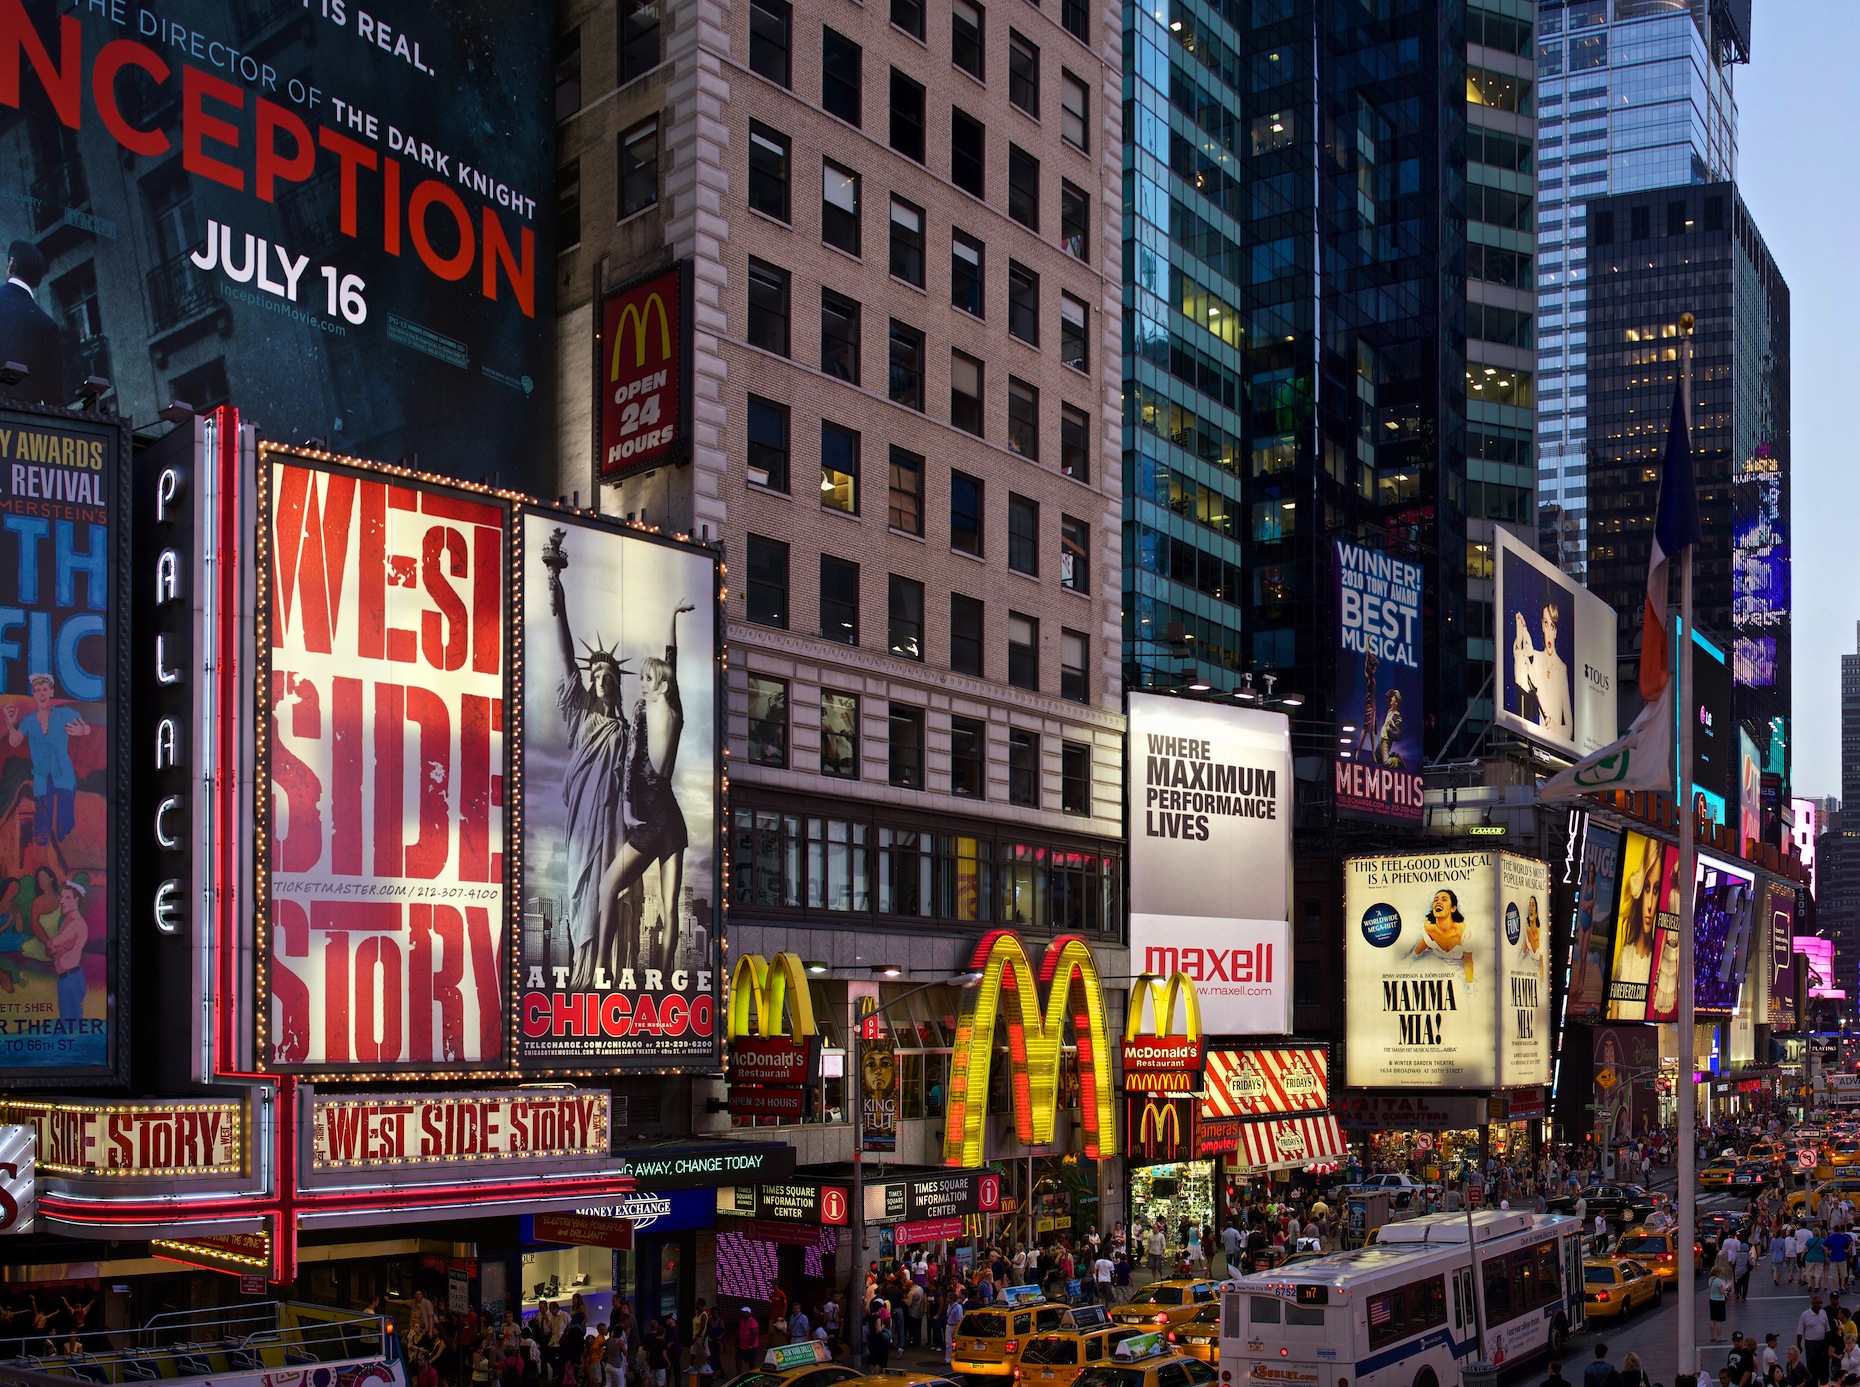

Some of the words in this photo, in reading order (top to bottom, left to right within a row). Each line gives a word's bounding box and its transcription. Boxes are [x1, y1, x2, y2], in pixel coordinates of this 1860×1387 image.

[358, 12, 436, 76] REAL.
[140, 9, 276, 92] DIRECTOR
[288, 79, 321, 109] OF
[332, 98, 378, 141] THE
[389, 125, 450, 177] DARK
[458, 159, 536, 221] KNIGHT
[190, 219, 310, 302] JULY
[321, 265, 367, 325] 16
[221, 281, 346, 338] InceptionMovie.com
[614, 369, 668, 405] OPEN
[620, 395, 661, 442] 24
[16, 432, 103, 471] AWARDS
[607, 425, 674, 465] HOURS
[12, 463, 105, 507] REVIVAL
[1337, 541, 1421, 591] WINNER!
[1341, 568, 1363, 588] 2010
[1367, 575, 1387, 599] TONY
[1391, 584, 1418, 607] AWARD
[1341, 588, 1418, 644] BEST
[1341, 629, 1418, 668] MUSICAL
[1589, 665, 1609, 691] TOUS
[1147, 733, 1211, 761] WHERE
[1147, 756, 1276, 798] MAXIMUM
[1335, 761, 1424, 807] MEMPHIS
[1147, 787, 1276, 820] PERFORMANCE
[1147, 810, 1210, 841] LIVES
[1471, 827, 1504, 835] LAMAR
[1381, 858, 1440, 872] FEEL-GOOD
[1444, 855, 1492, 869] MUSICAL
[1585, 847, 1616, 878] HUGE
[417, 886, 499, 900] 212-307-4100
[1368, 874, 1378, 885] IS
[1364, 914, 1398, 926] WORLDWIDE
[1145, 943, 1273, 983] maxell
[527, 966, 569, 988] AT
[595, 968, 712, 991] LARGE
[1511, 976, 1538, 1008] MAMMA
[1610, 983, 1647, 1000] FOREVER21.COM
[1383, 980, 1457, 1012] MAMMA
[14, 1018, 104, 1035] THEATER
[523, 992, 713, 1037] CHICAGO
[1517, 1009, 1533, 1039] MIA!
[1399, 1013, 1442, 1045] MIA!
[525, 1041, 642, 1049] TELECHARGE.COM/CHICAGO
[1125, 1047, 1197, 1059] McDonald's
[728, 1052, 804, 1067] McDonald's
[1136, 1059, 1185, 1068] Restaurant
[738, 1069, 790, 1078] Restaurant
[1232, 1079, 1262, 1090] FRIDAY'S
[1286, 1078, 1312, 1089] FRIDAY'S
[729, 1097, 752, 1107] OPEN
[767, 1098, 798, 1108] HOURS
[864, 1099, 895, 1112] KING
[50, 1110, 95, 1166] SIDE
[108, 1112, 221, 1168] STORY
[326, 1106, 414, 1160] WEST
[421, 1103, 500, 1156] SIDE
[511, 1100, 593, 1151] STORY
[635, 1161, 672, 1176] AWAY,
[675, 1157, 722, 1173] CHANGE
[725, 1155, 763, 1169] TODAY
[762, 1184, 784, 1195] TIMES
[786, 1186, 815, 1198] SQUARE
[914, 1182, 938, 1193] TIMES
[939, 1178, 969, 1190] SQUARE
[916, 1191, 967, 1206] INFORMATION
[615, 1201, 671, 1216] EXCHANGE
[763, 1196, 813, 1208] INFORMATION
[774, 1207, 802, 1218] CENTER
[928, 1205, 956, 1217] CENTER
[1275, 1287, 1296, 1297] 6752
